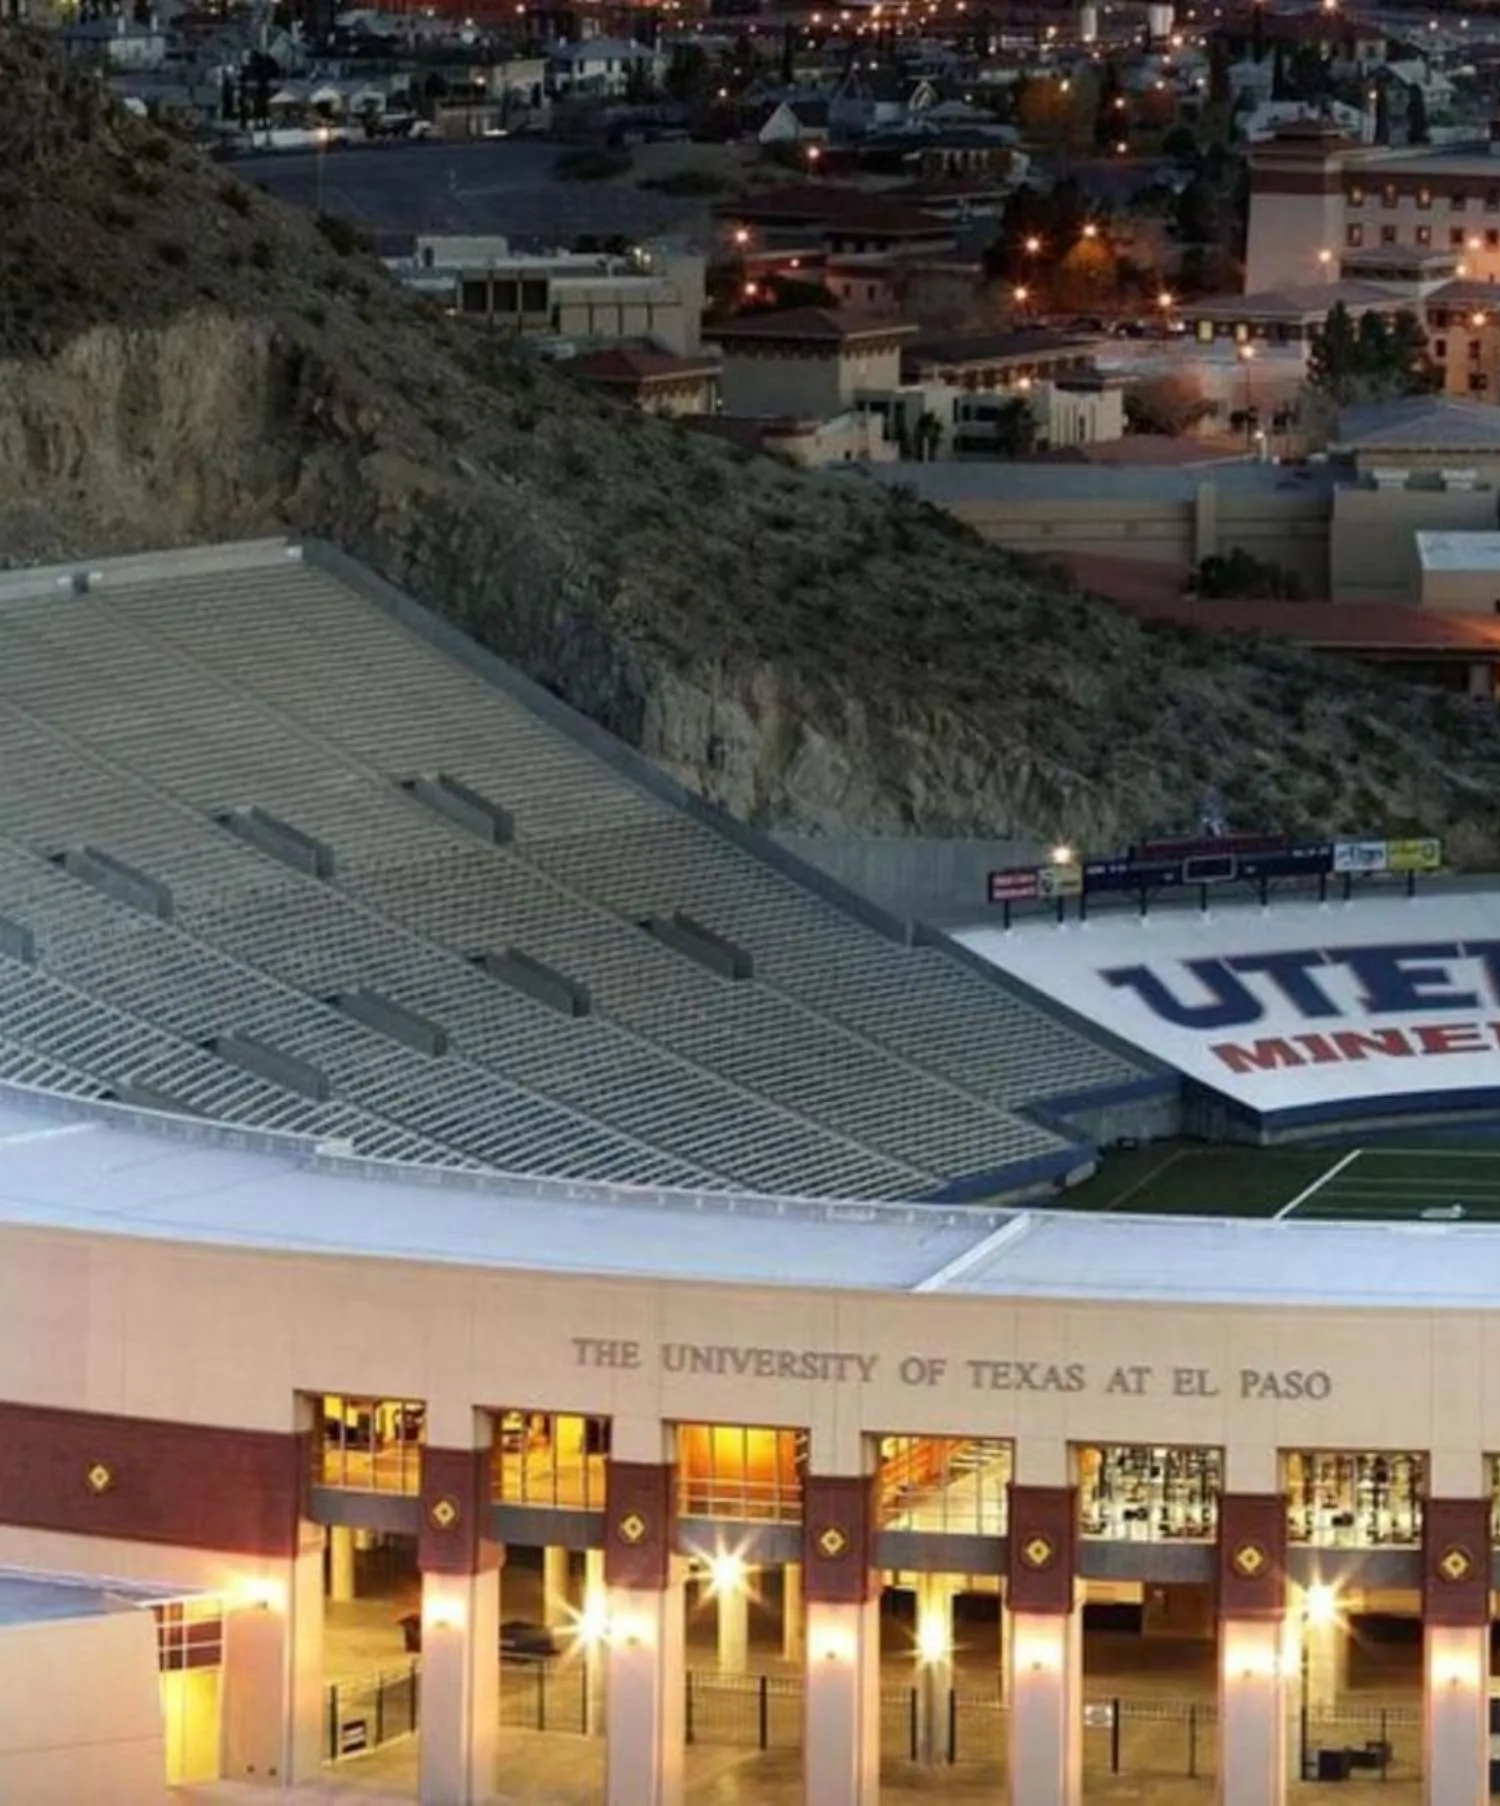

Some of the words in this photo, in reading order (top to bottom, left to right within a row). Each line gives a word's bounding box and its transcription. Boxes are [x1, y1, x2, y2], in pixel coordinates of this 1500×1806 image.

[571, 1337, 642, 1369] THE
[661, 1343, 880, 1382] UNIVERSITY
[900, 1355, 948, 1386] OF
[966, 1359, 1087, 1393] TEXAS
[1105, 1366, 1153, 1395] AT
[1172, 1367, 1220, 1397] EL
[1239, 1369, 1332, 1400] PASO
